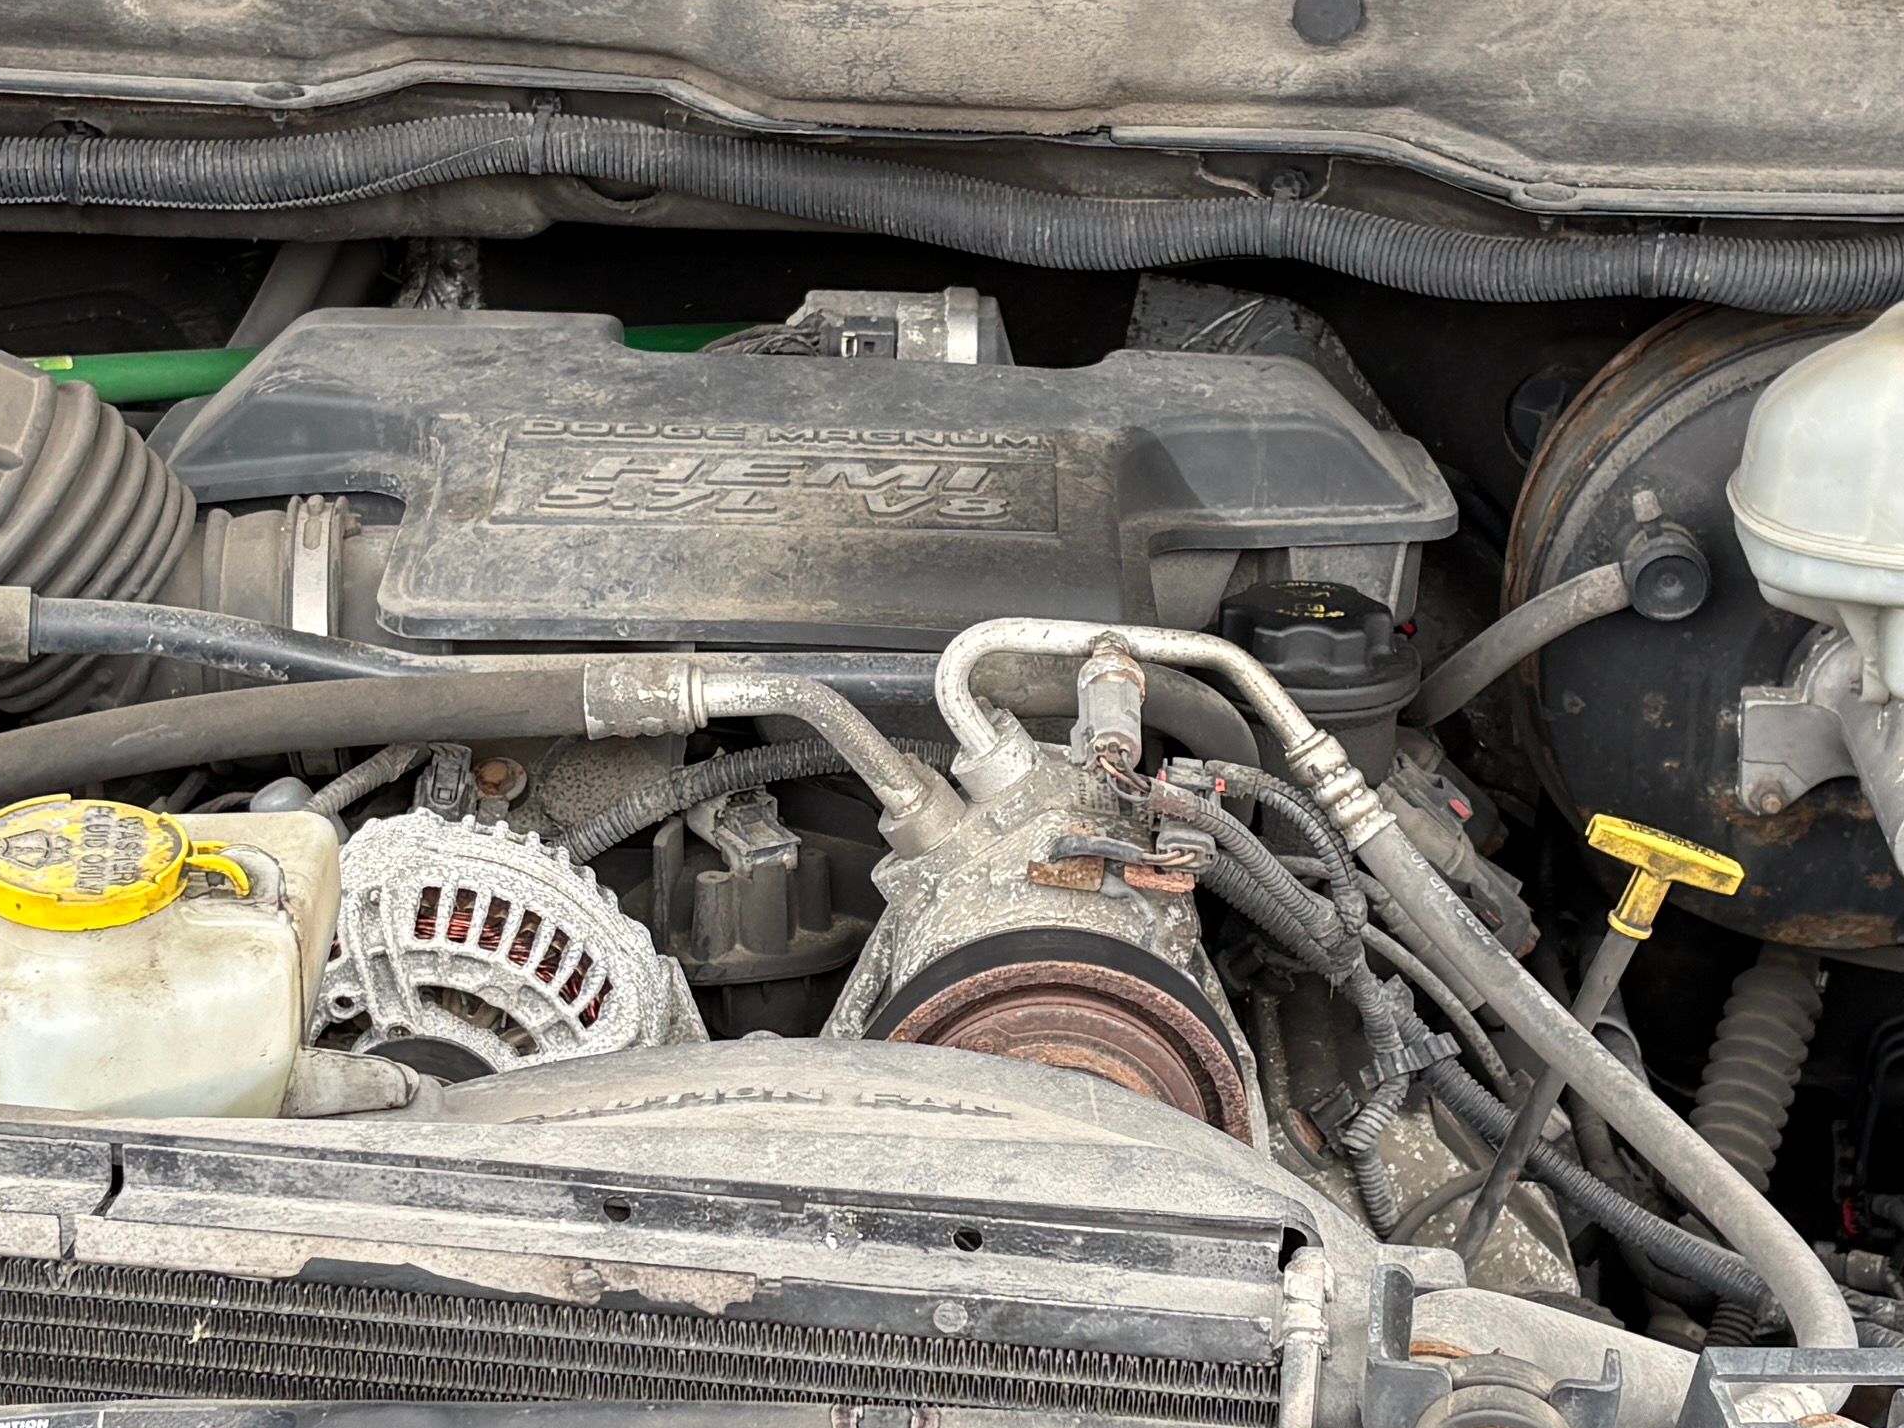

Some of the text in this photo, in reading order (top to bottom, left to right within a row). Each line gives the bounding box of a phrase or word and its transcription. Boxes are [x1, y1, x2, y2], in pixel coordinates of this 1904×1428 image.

[522, 418, 1039, 450] DODGE MAGNUM
[583, 456, 993, 494] HEMI
[537, 487, 1011, 520] 5.7L V8
[500, 1087, 1014, 1125] CAUTION FAN
